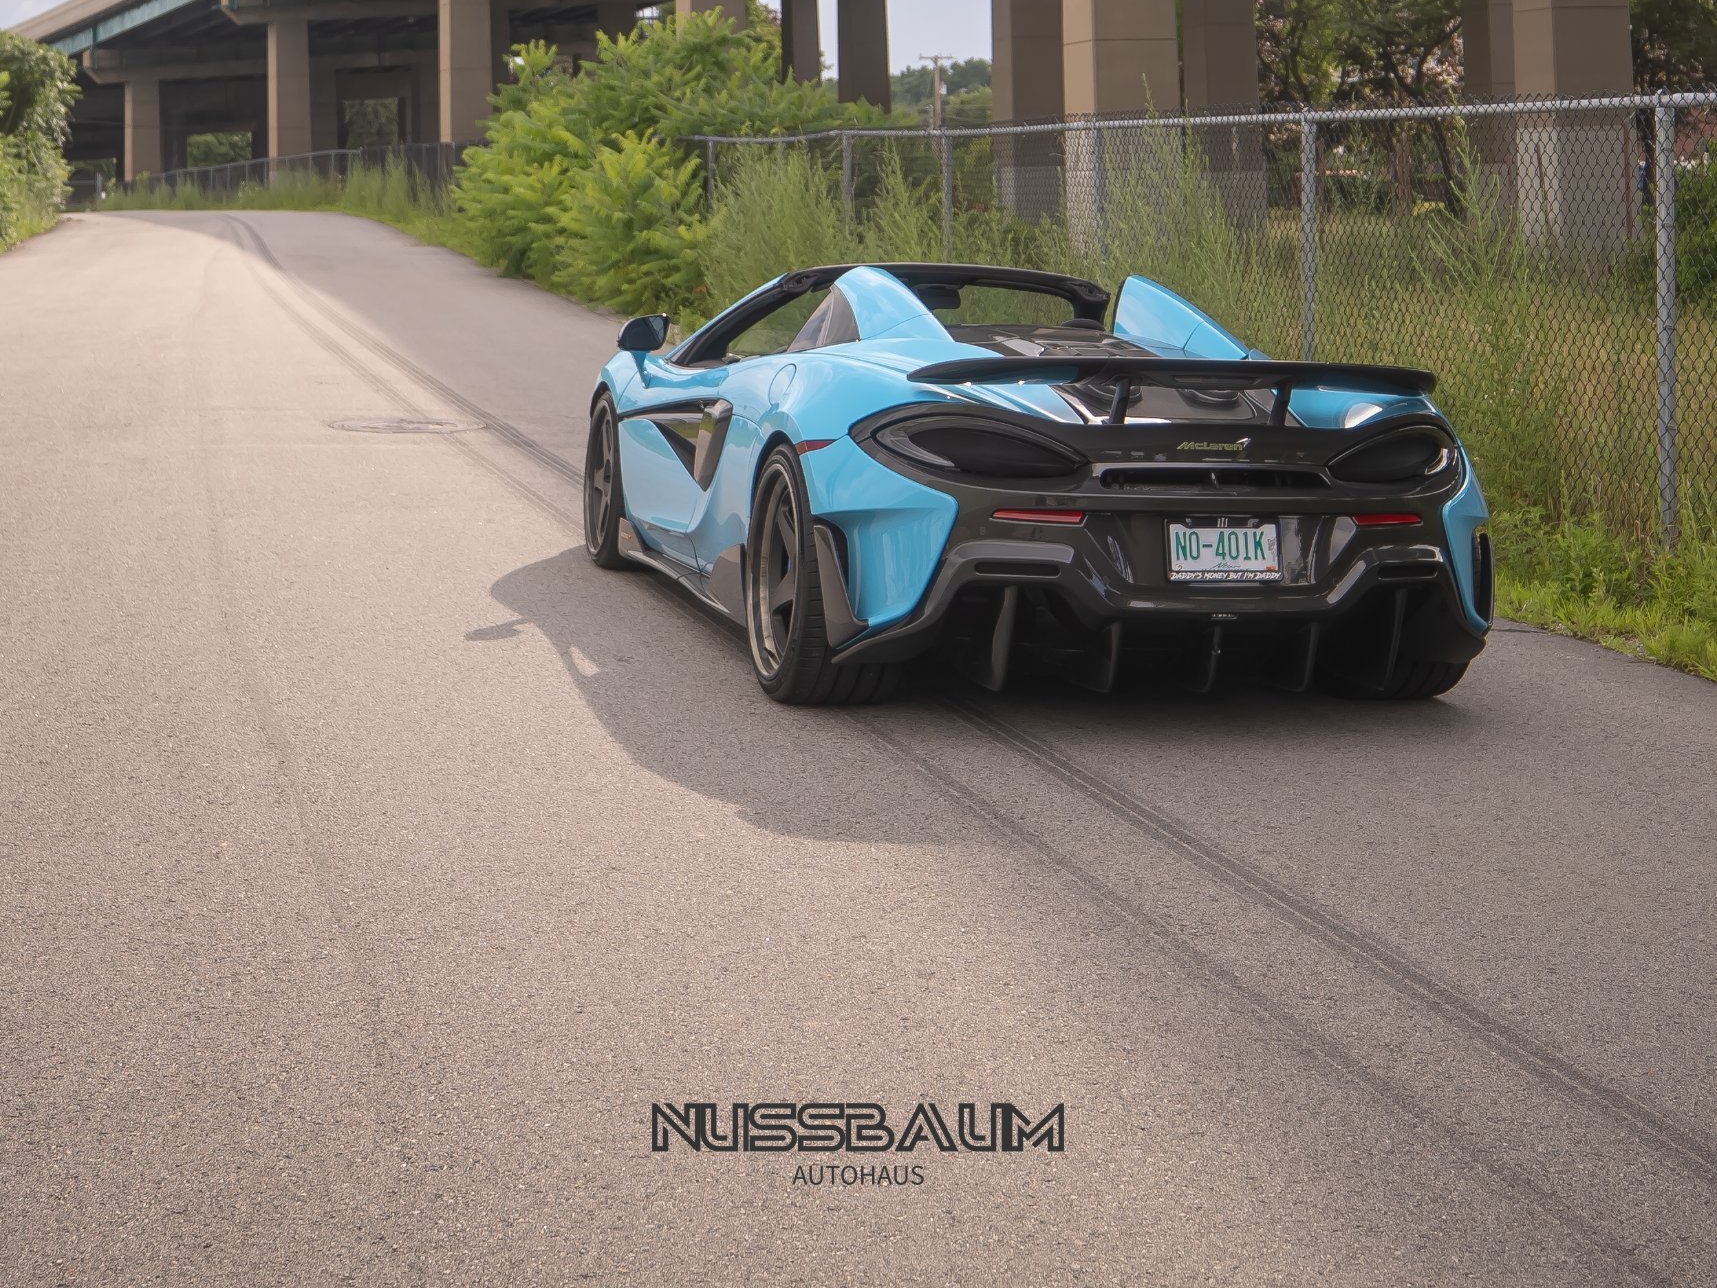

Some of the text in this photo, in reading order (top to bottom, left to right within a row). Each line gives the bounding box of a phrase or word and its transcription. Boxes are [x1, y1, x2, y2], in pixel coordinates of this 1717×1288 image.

[1176, 440, 1244, 452] McLaren
[1170, 572, 1282, 581] DADDY'S MONEY BUT I'M DADDY
